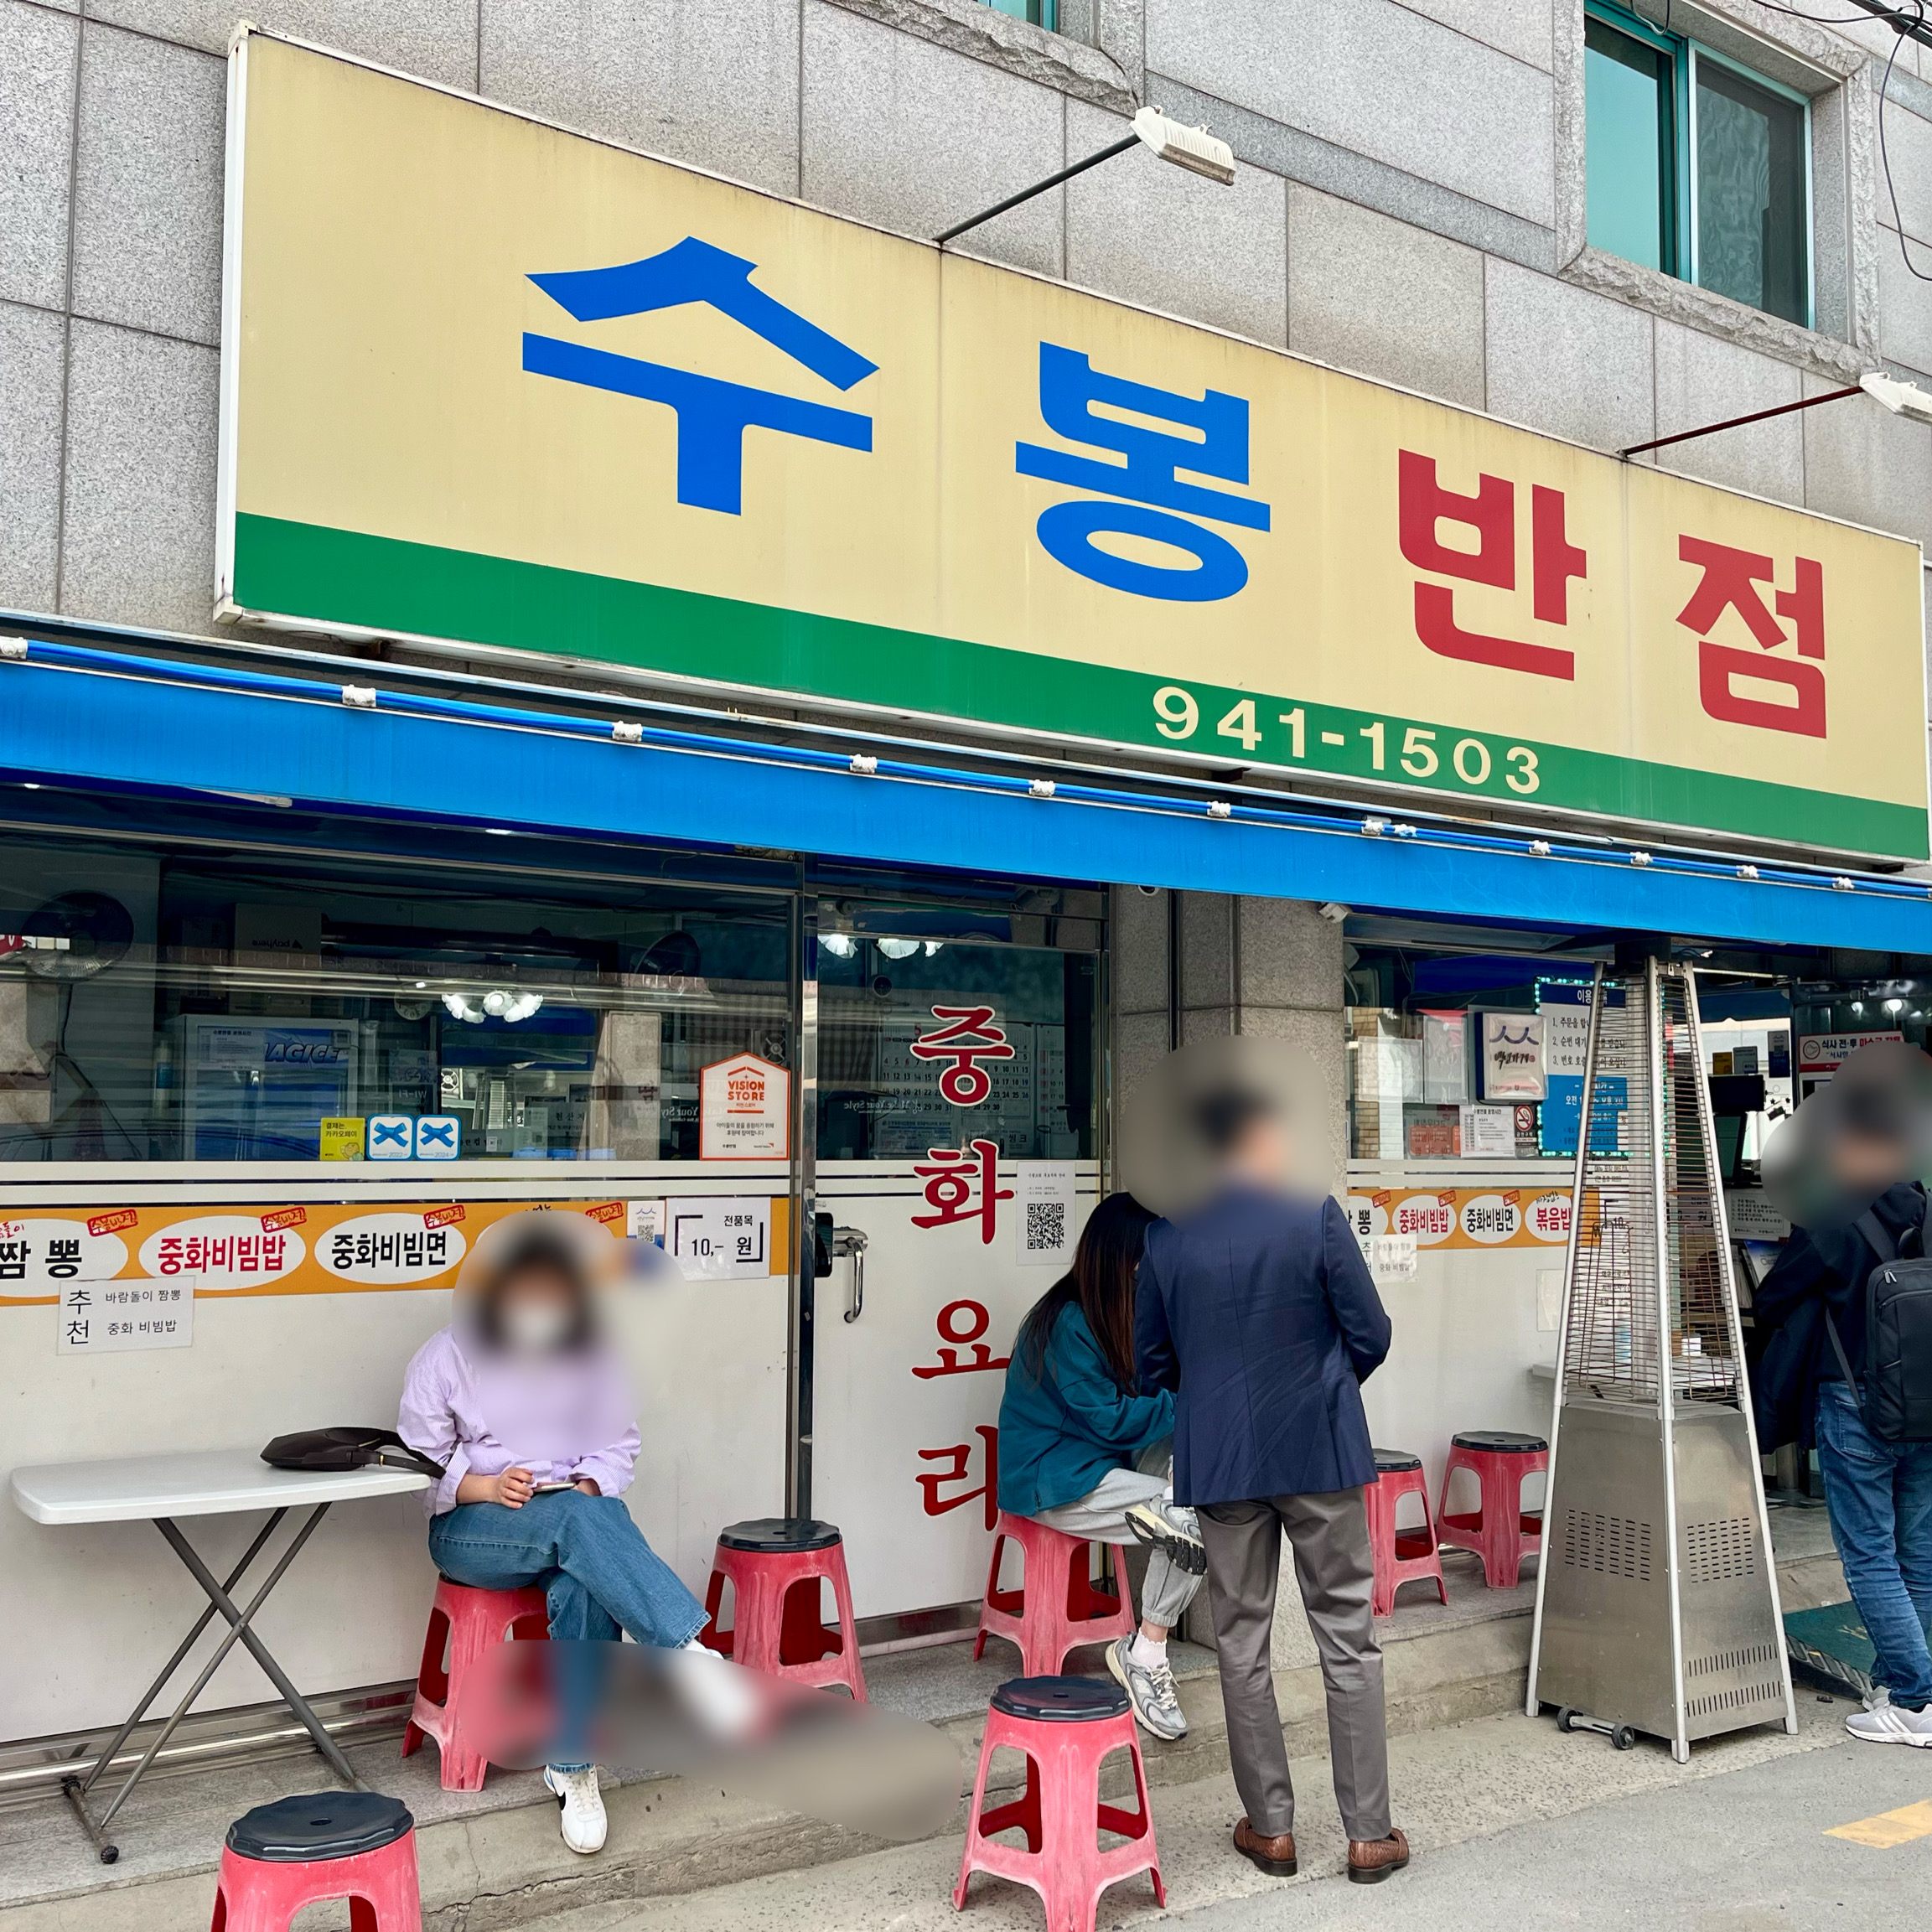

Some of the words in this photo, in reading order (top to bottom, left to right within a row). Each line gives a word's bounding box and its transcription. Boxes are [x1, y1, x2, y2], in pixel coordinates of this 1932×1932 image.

[523, 236, 1827, 739] 수봉반점
[1152, 686, 1541, 795] 941-1503
[264, 1042, 339, 1064] AGICE
[728, 1080, 764, 1090] VISION
[728, 1091, 764, 1101] STORE
[723, 1215, 753, 1226] 전품목
[1400, 1208, 1449, 1234] 중화비빔밥
[1467, 1208, 1514, 1233] 중화비빔면
[1536, 1207, 1572, 1231] 볶음밥
[158, 1235, 287, 1276] 중화비빔밥
[331, 1231, 446, 1270] 중화비빔면
[736, 1236, 753, 1256] 원
[106, 1290, 153, 1304] 바람돌이
[158, 1288, 181, 1303] 짬뽕
[107, 1321, 133, 1336] 중화
[139, 1318, 178, 1334] 비빔밥
